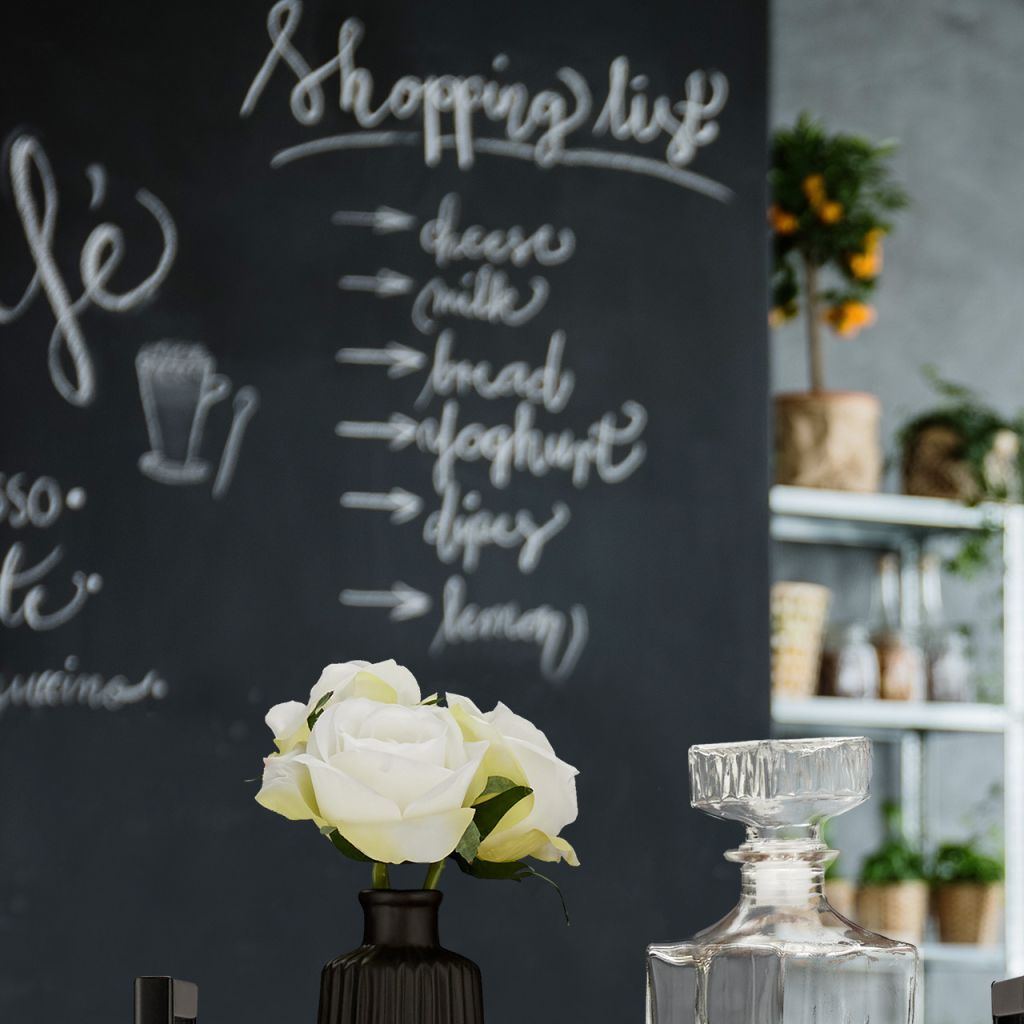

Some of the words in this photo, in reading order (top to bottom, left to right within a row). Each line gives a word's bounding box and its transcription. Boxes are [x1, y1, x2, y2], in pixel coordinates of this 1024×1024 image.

[240, 0, 592, 171] Shopping
[591, 56, 730, 168] list
[419, 192, 577, 268] cheese
[411, 263, 551, 335] milk
[413, 328, 576, 414] bread
